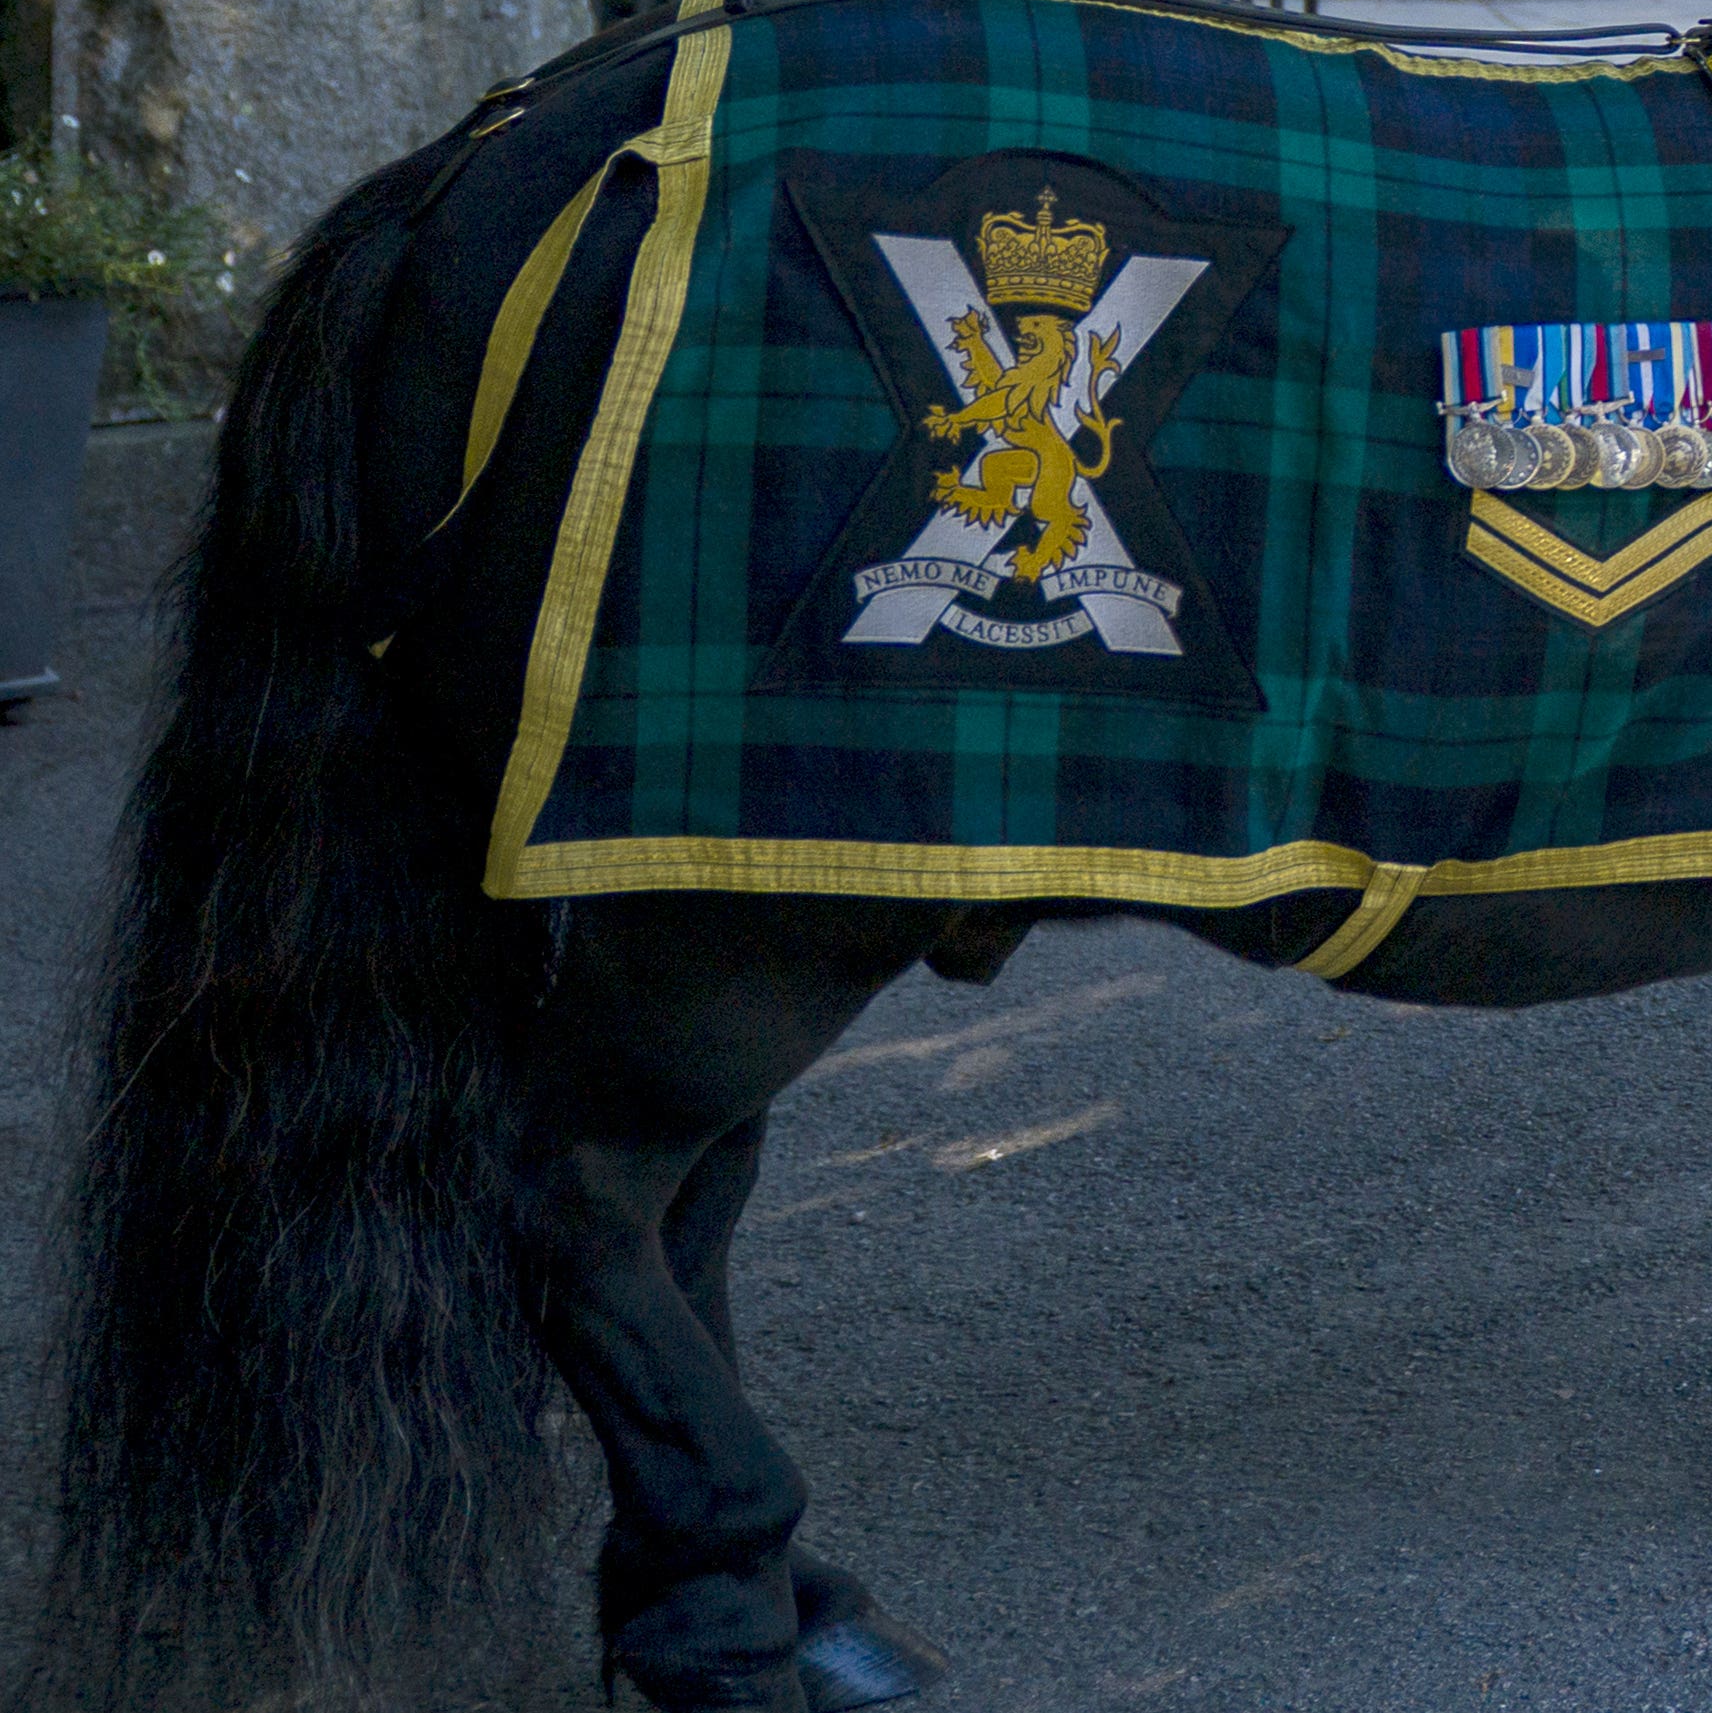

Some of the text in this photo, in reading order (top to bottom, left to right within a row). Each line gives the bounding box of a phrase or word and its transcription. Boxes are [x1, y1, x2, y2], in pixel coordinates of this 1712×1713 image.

[863, 561, 1168, 601] NEMO ME IMPUNE
[954, 612, 1082, 644] LACESSIT
